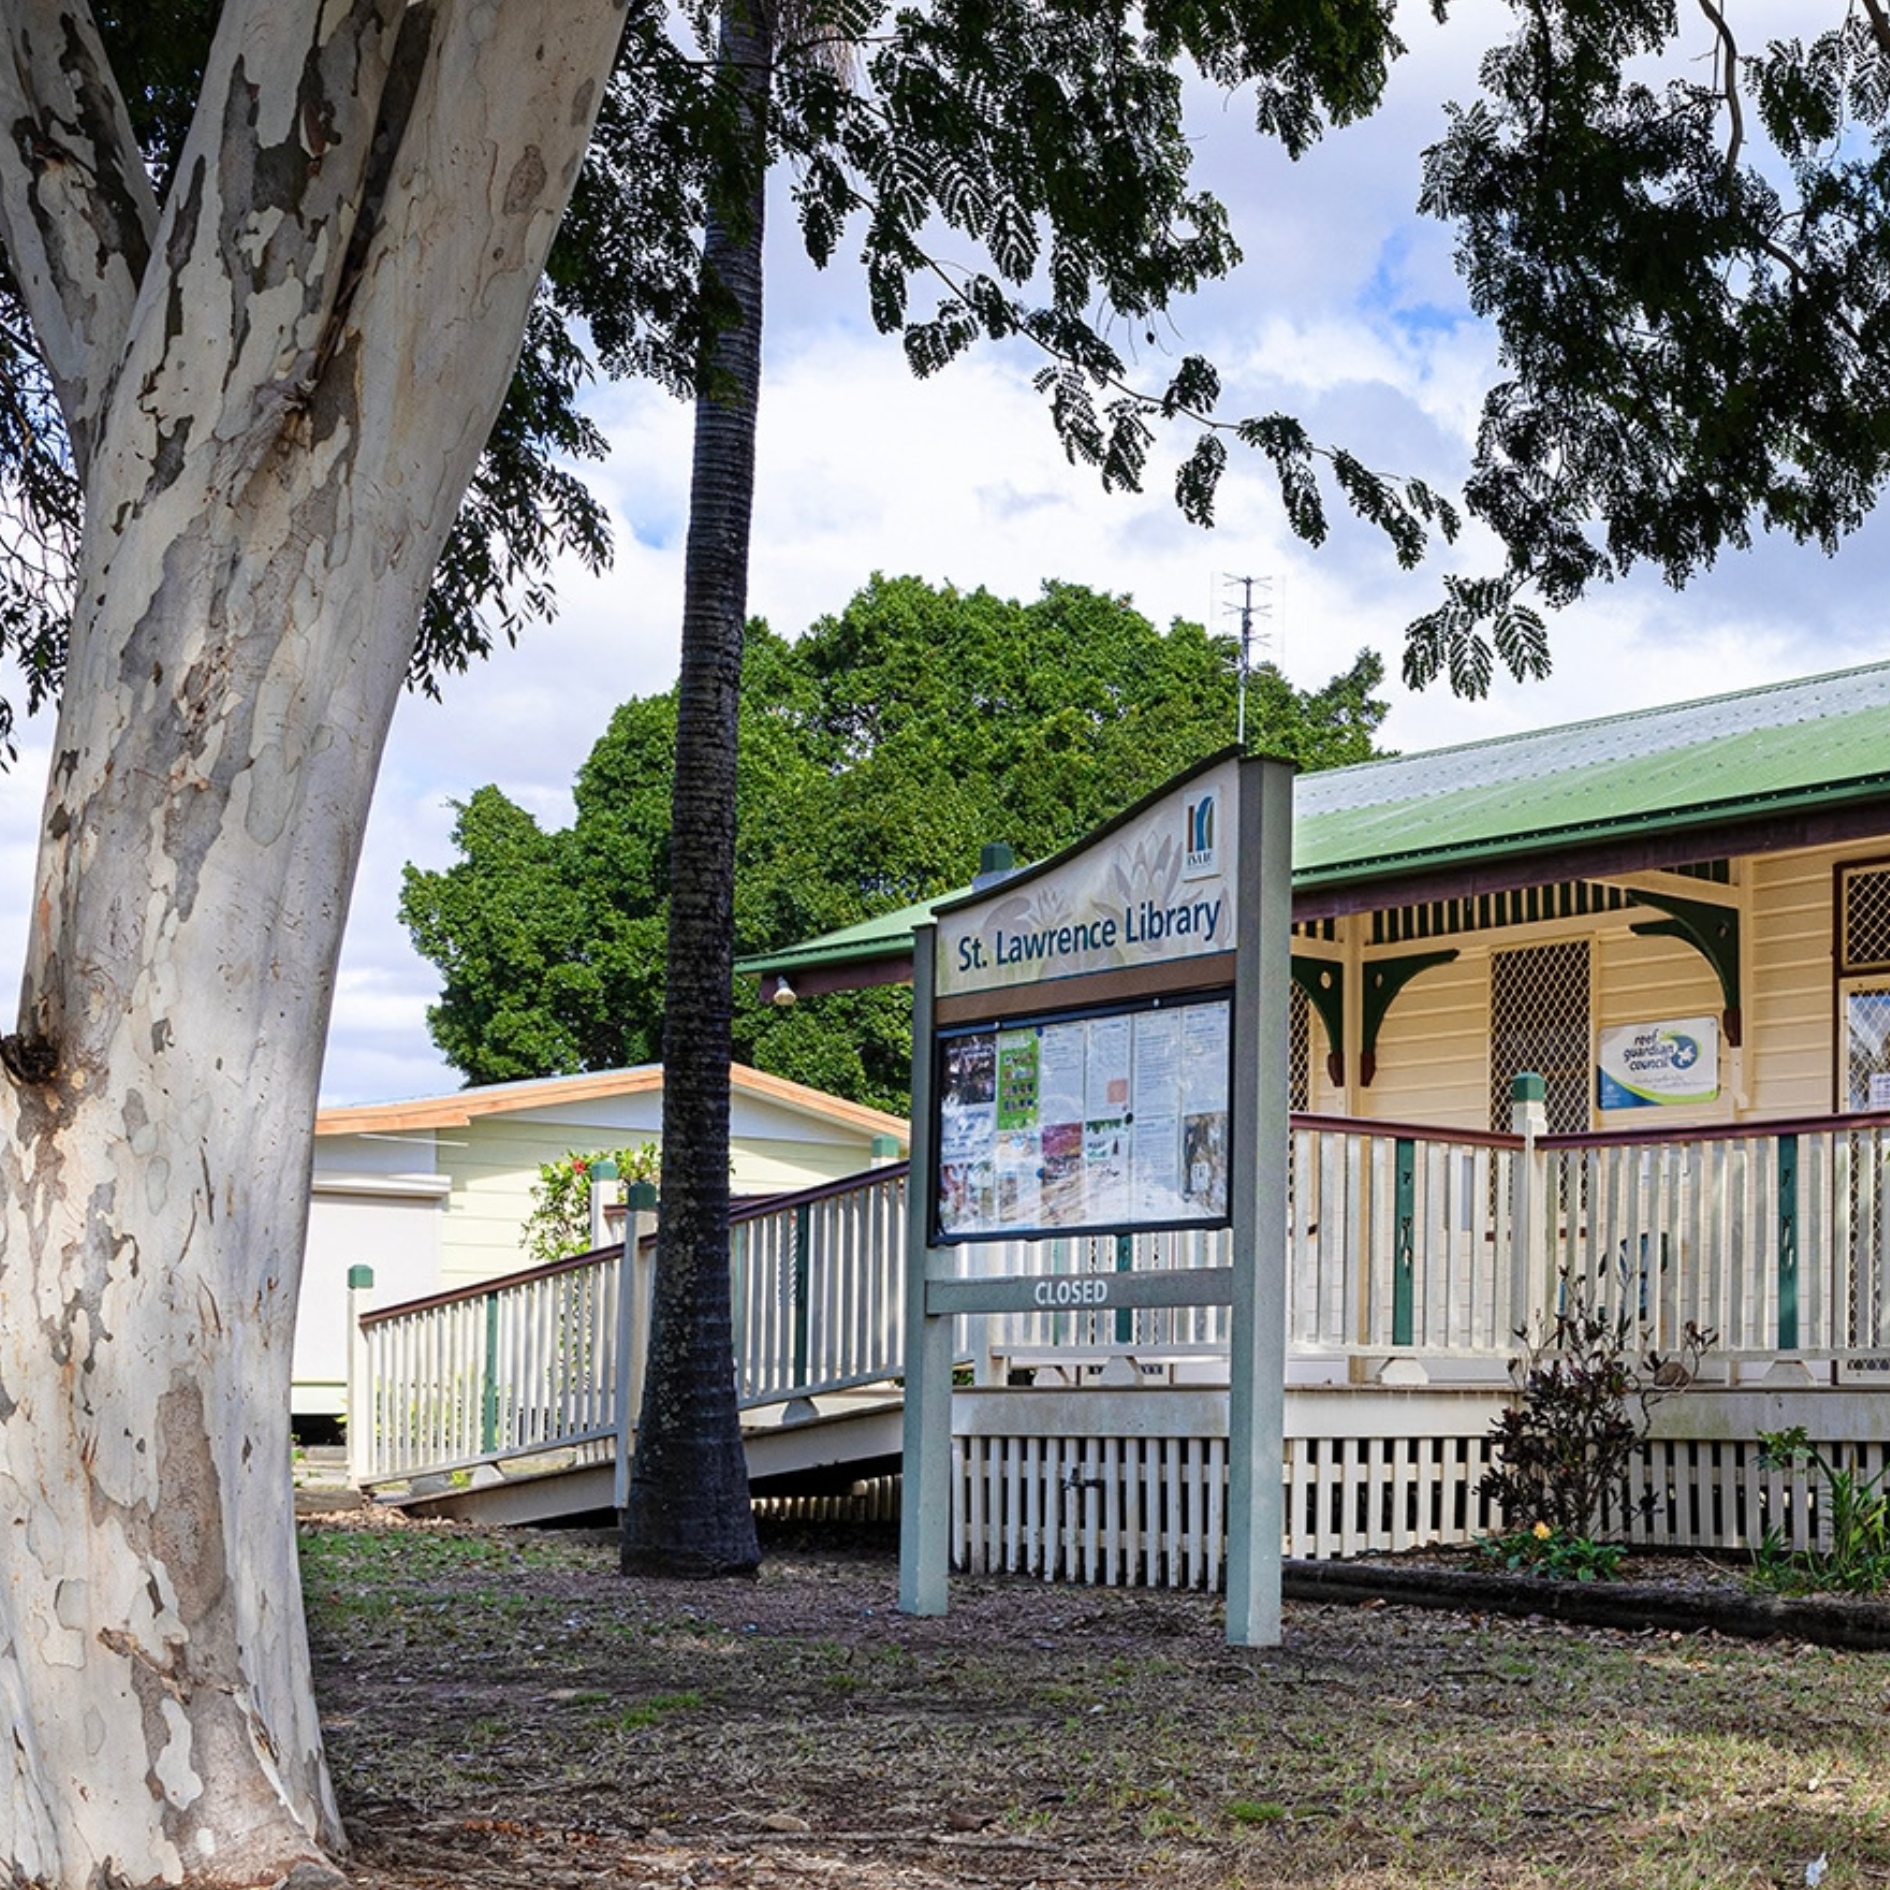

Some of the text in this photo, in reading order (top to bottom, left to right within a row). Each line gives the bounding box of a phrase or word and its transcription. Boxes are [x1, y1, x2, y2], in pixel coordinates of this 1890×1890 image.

[958, 899, 1221, 971] St. Lawrence Library
[1634, 1028, 1659, 1046] reef
[1623, 1044, 1674, 1063] guardian
[1629, 1057, 1670, 1072] council
[1034, 1280, 1108, 1306] CLOSED
